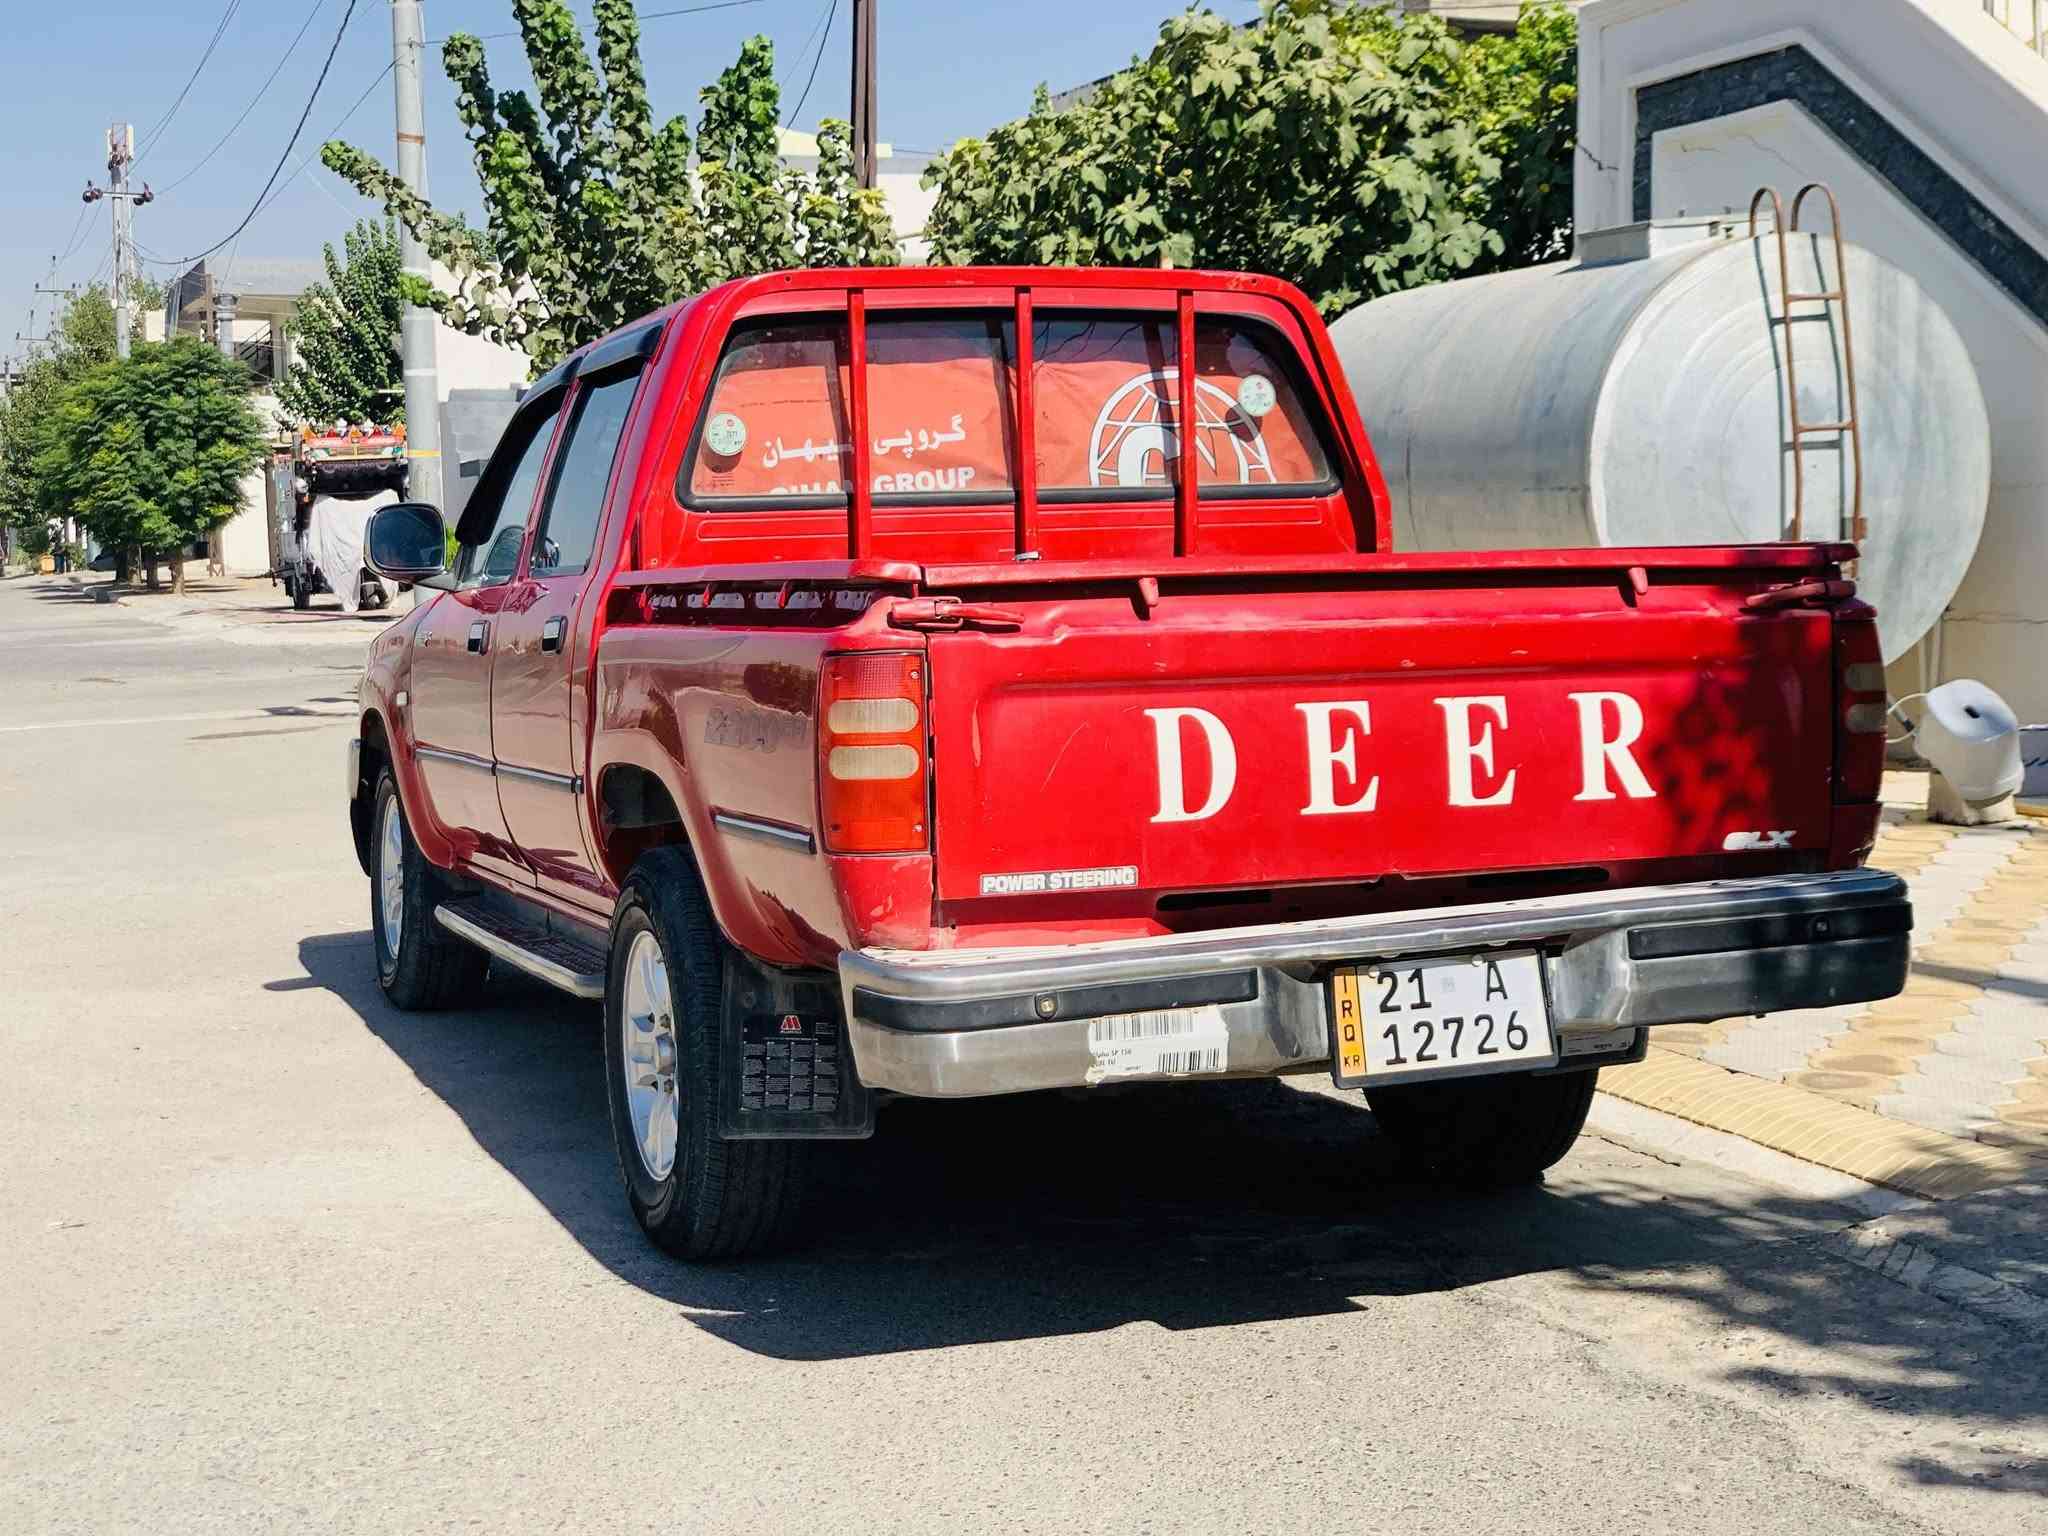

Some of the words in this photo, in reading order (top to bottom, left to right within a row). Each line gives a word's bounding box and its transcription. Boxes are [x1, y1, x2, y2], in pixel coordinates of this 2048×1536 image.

[762, 432, 855, 468] یهان
[874, 466, 975, 493] GROUP
[1143, 690, 1657, 824] DEER
[982, 873, 1046, 893] POWER
[1049, 867, 1135, 889] STEERING
[1377, 968, 1432, 1013] 21
[1486, 961, 1508, 1001] A
[1383, 1010, 1529, 1066] 12726
[1343, 1053, 1361, 1068] KR
